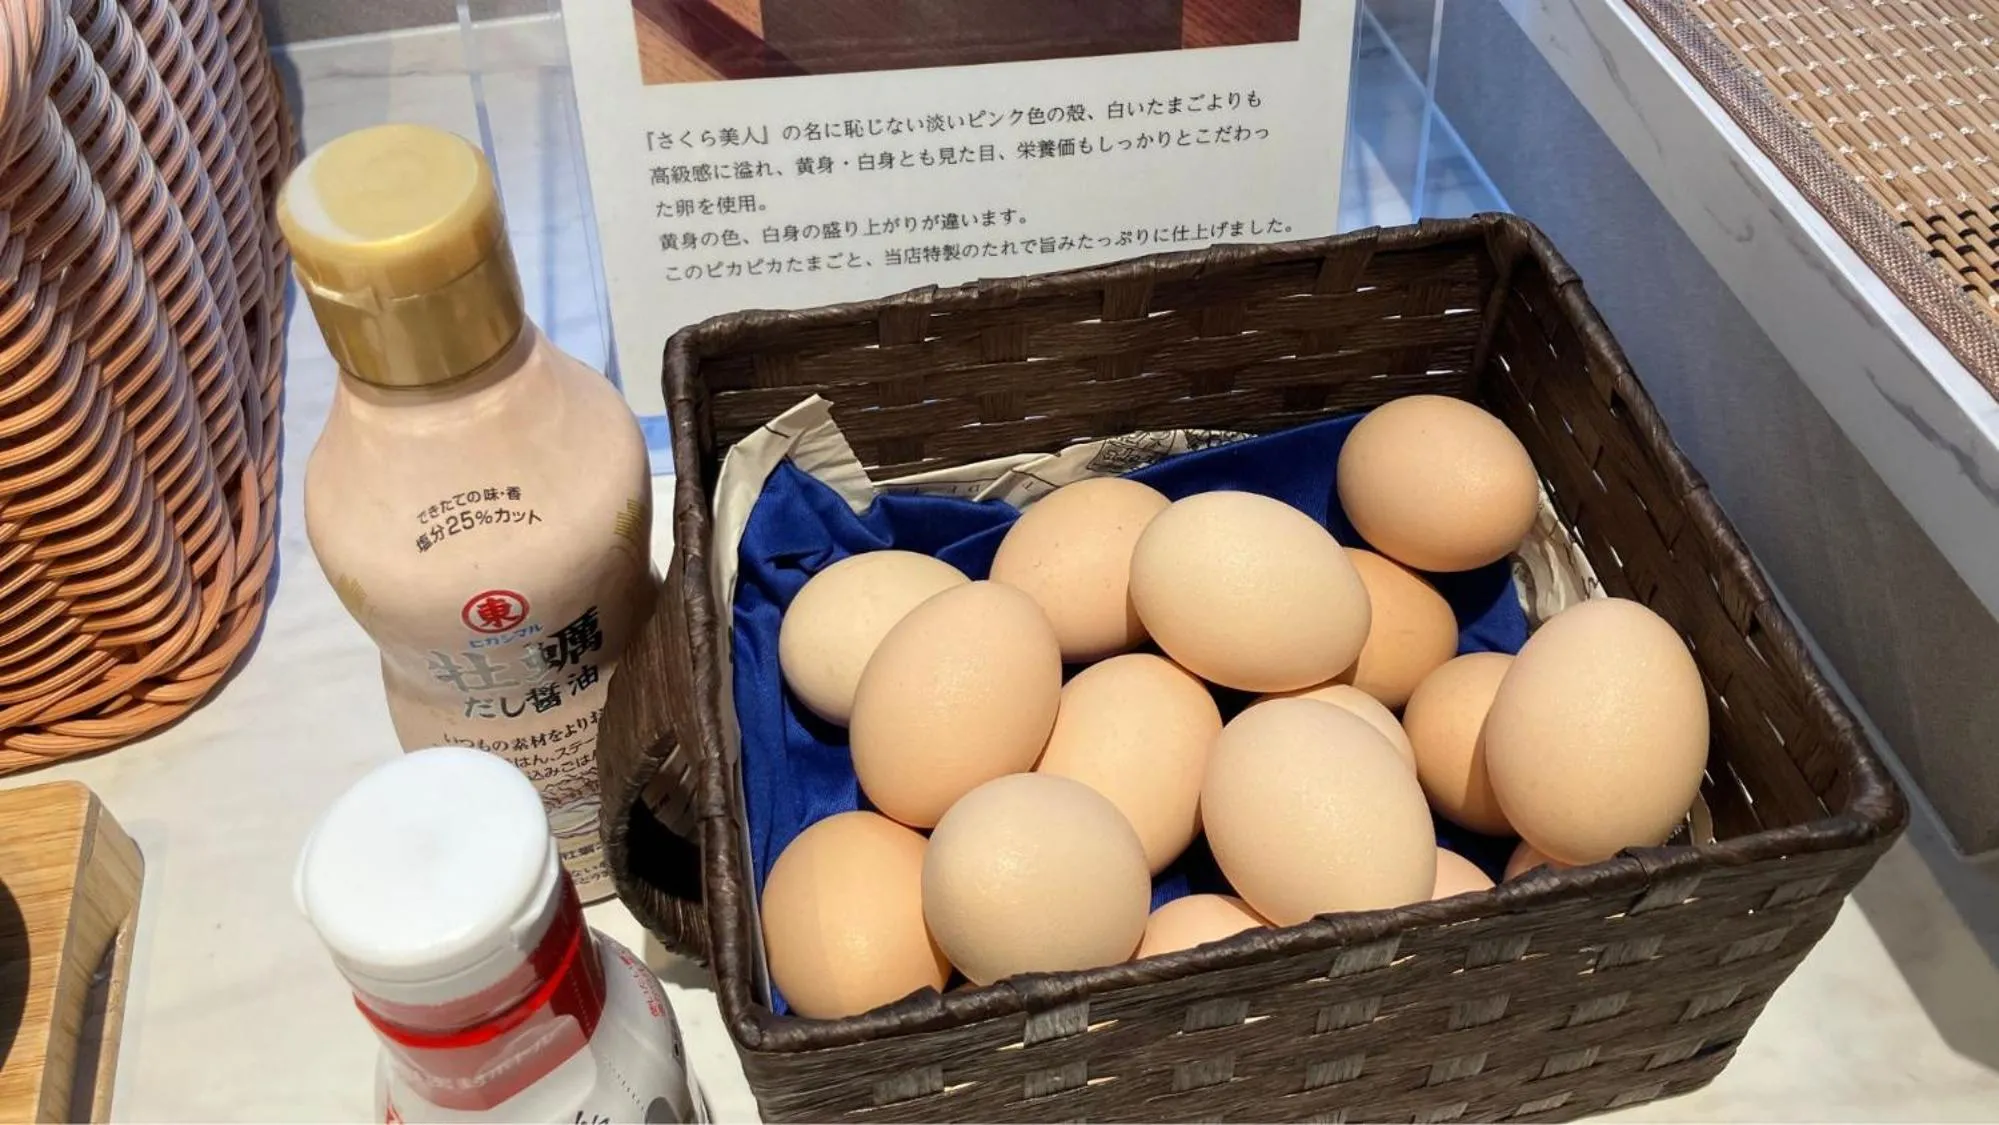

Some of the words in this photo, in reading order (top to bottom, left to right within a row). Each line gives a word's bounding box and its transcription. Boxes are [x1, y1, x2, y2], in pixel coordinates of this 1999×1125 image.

[646, 90, 1262, 151] 『さくら美人』の名に恥じない淡いピンク色の殻、白いたまごよりも
[650, 125, 1270, 186] 高級感に溢れ、黄身・白身とも見た目、栄養価もしっかりとこだわっ
[656, 194, 768, 218] た卵を使用。
[660, 208, 1027, 251] 黄身の色、白身の盛り上がりが違います。
[666, 217, 1294, 281] このピカピカたまごと、当店特製のたれで旨みたっぷりに仕上げました。
[417, 486, 521, 524] できたての味・香
[416, 508, 543, 553] 塩分25%カット
[476, 597, 520, 628] 東
